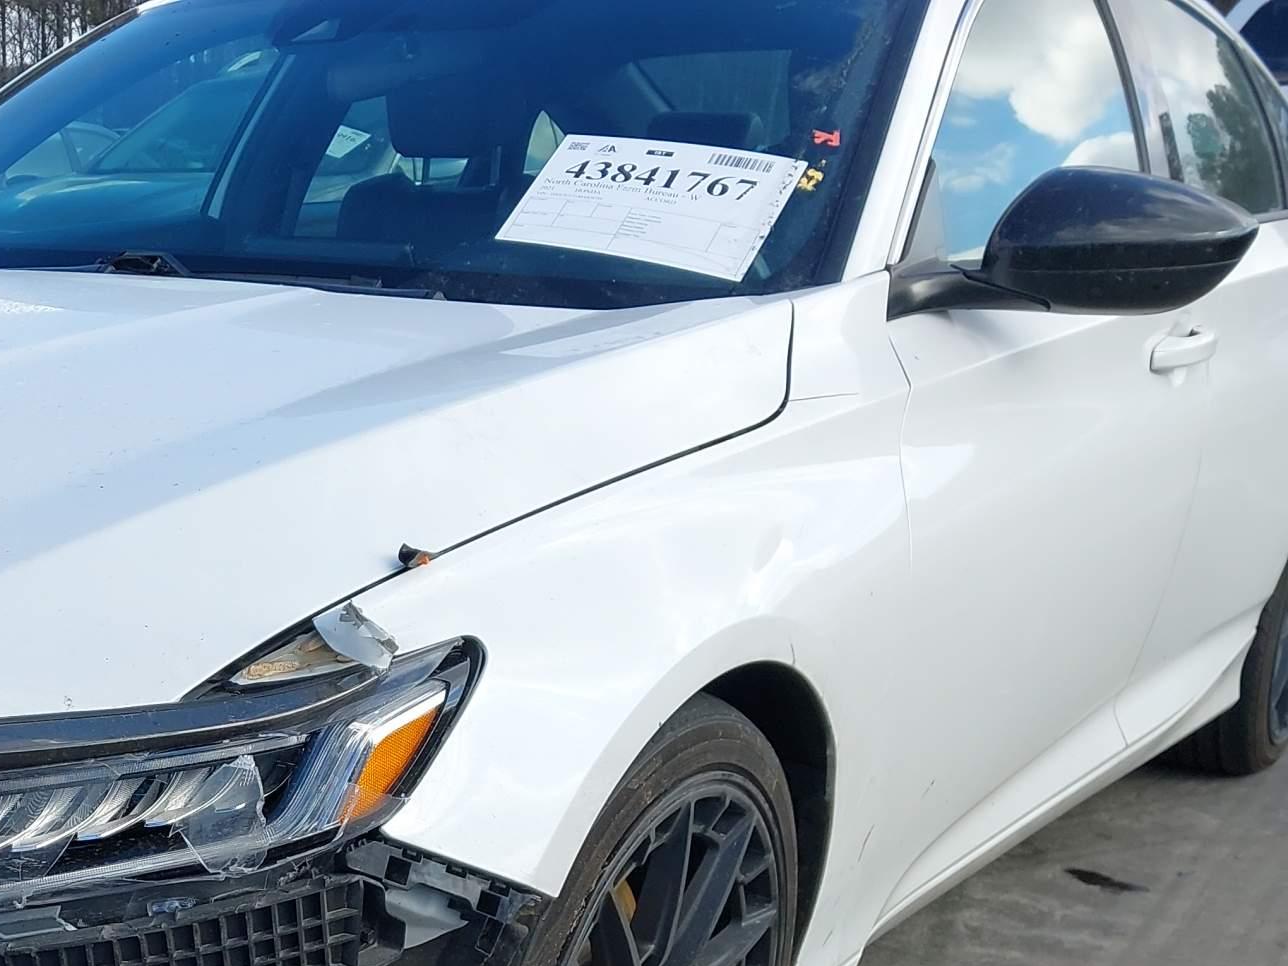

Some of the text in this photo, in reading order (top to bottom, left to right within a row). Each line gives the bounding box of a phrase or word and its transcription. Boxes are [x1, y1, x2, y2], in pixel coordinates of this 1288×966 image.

[544, 178, 571, 186] North
[573, 179, 614, 190] Carolina
[644, 187, 680, 199] Bureau
[565, 159, 760, 201] 43841767
